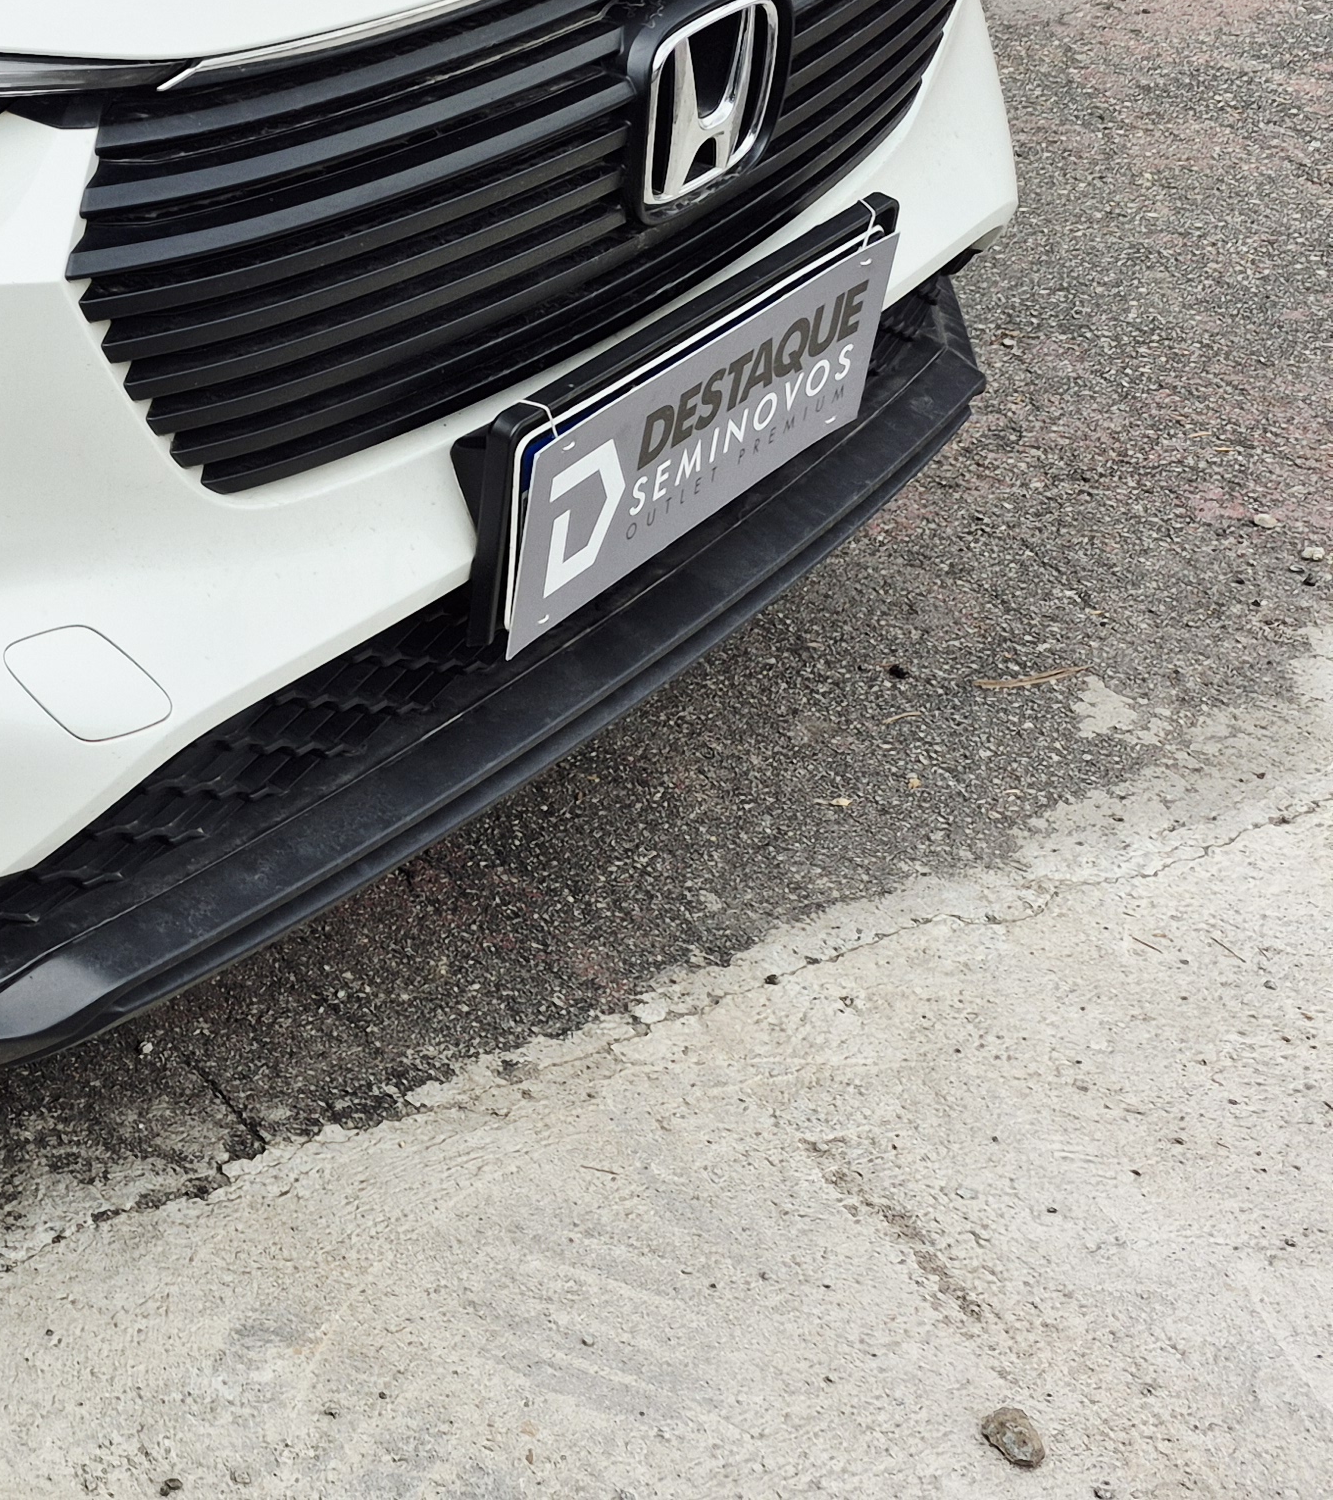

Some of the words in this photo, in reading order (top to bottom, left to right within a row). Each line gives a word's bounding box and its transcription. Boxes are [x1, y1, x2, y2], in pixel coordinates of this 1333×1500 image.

[628, 342, 854, 518] SEMINOVOS
[637, 279, 869, 470] DESTAQUE
[625, 466, 718, 542] OUTLET
[737, 384, 848, 469] PREMIUM
